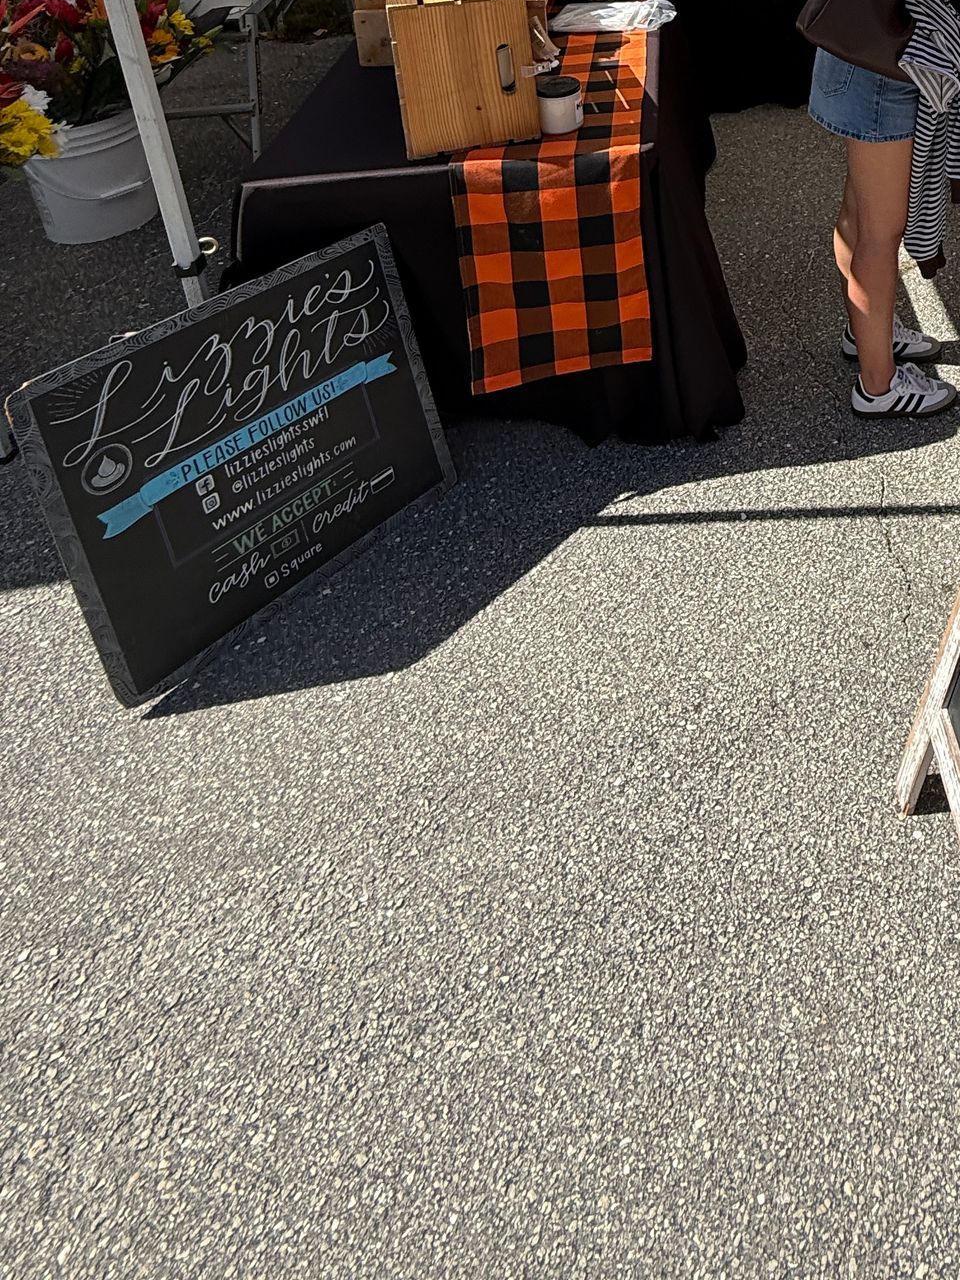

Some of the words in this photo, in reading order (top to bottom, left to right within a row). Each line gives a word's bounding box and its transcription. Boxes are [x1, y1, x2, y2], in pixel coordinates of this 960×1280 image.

[50, 260, 373, 467] Lizzie's
[132, 287, 389, 467] Lights
[182, 433, 245, 482] PLEASE
[248, 398, 307, 443] FOLLOW
[312, 382, 336, 407] US!
[232, 437, 315, 494] @lizzieslights
[212, 435, 356, 531] www.lizzieslights.com
[209, 551, 271, 604] cash
[312, 480, 369, 534] credit
[232, 523, 268, 555] WE
[281, 542, 322, 577] Square
